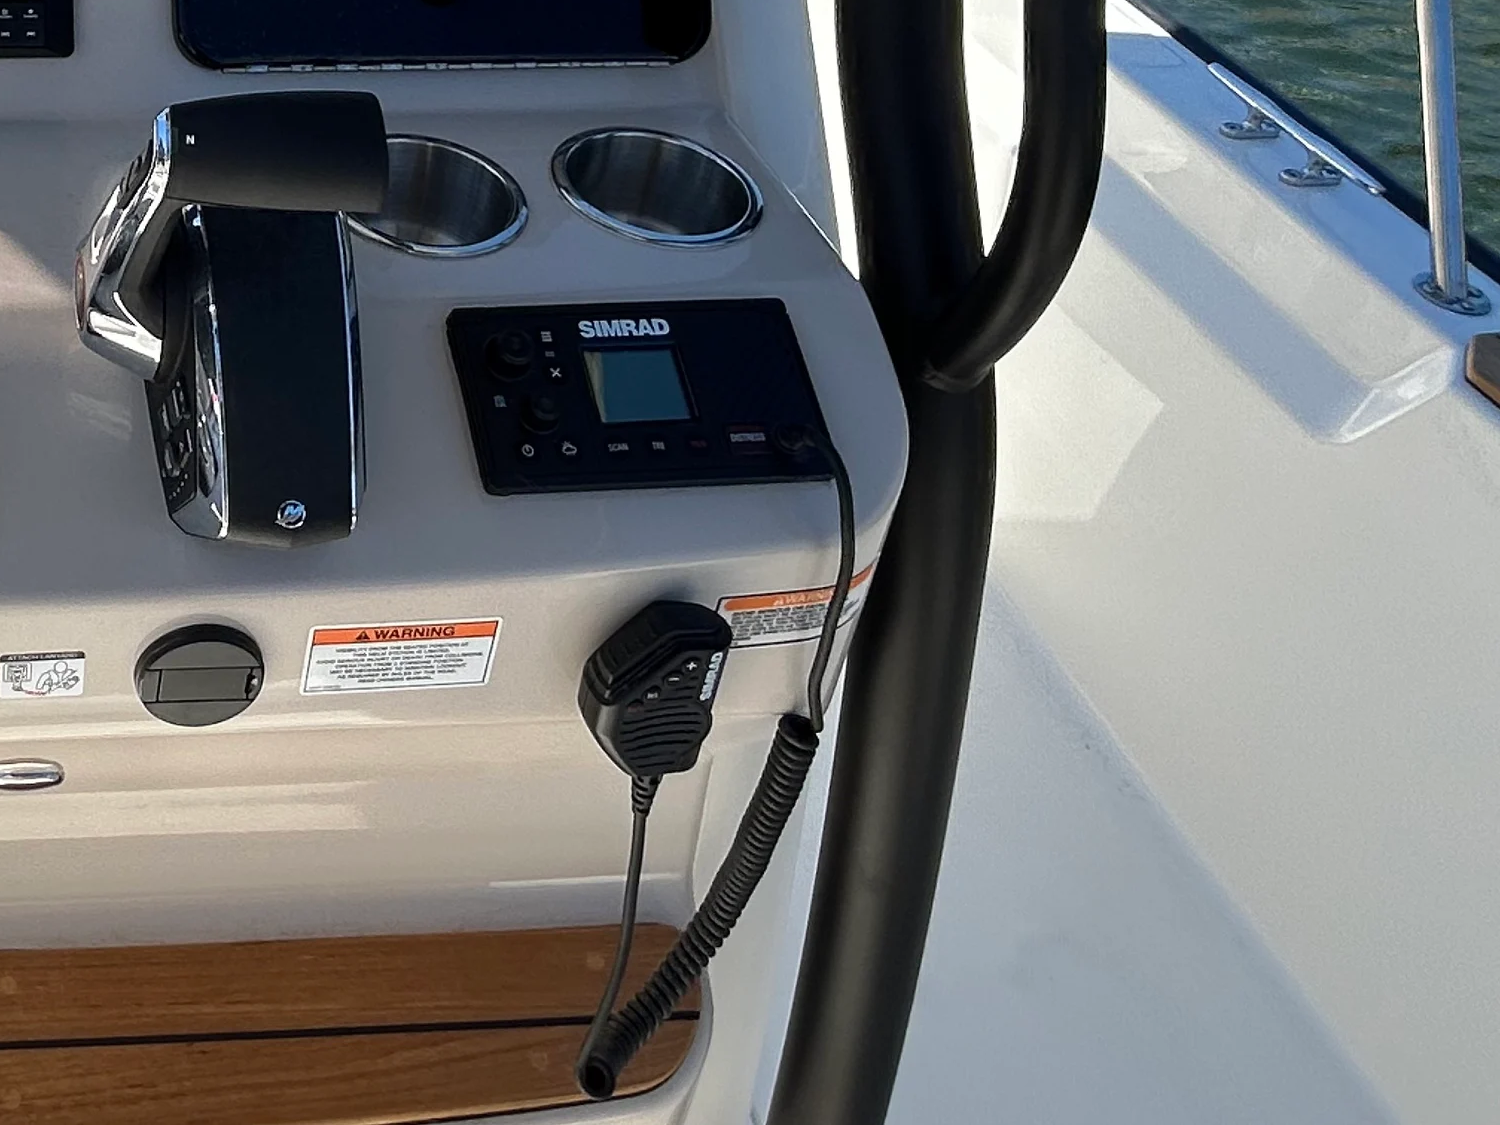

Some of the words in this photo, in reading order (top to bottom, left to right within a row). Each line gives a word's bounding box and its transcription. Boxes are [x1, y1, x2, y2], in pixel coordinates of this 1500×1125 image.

[186, 135, 194, 144] N
[578, 318, 670, 338] SIMRAD
[608, 443, 629, 452] SCAN
[374, 626, 455, 640] WARNING
[700, 652, 723, 701] SIMRAD
